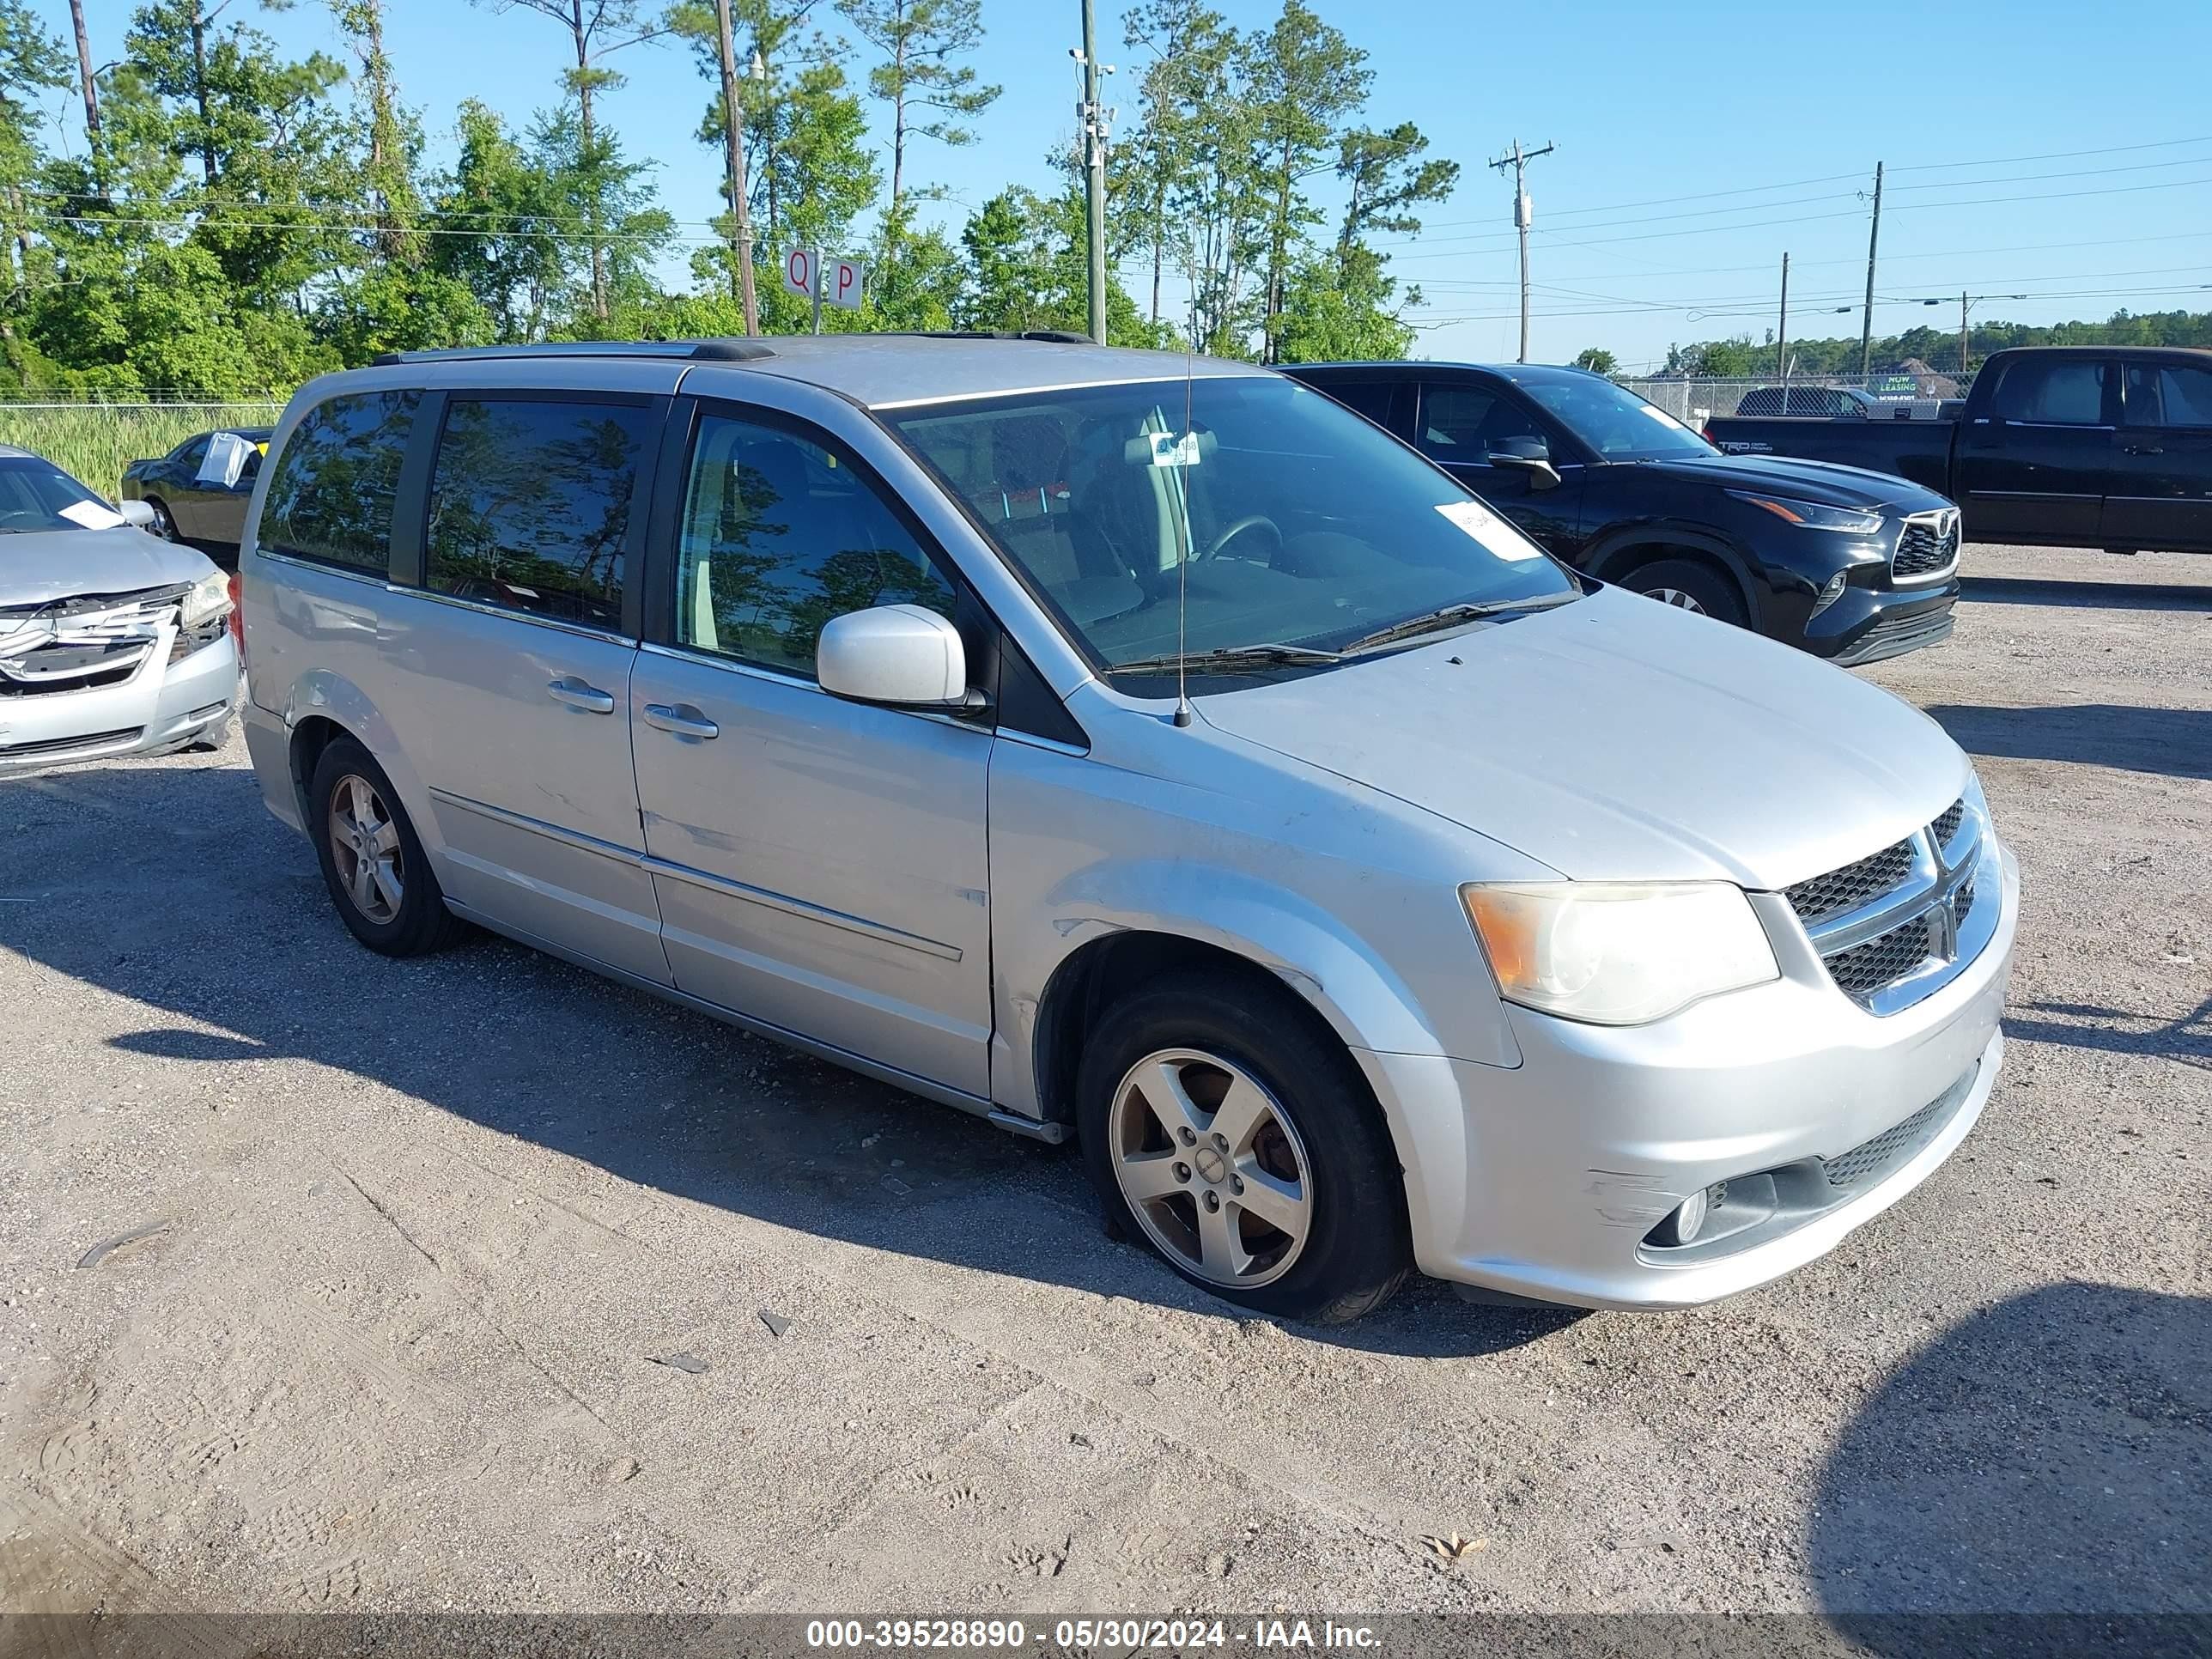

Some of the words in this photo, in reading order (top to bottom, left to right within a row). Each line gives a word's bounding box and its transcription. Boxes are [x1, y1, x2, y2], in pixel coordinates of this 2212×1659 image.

[790, 251, 810, 294] Q
[838, 264, 854, 301] P
[1881, 383, 1917, 392] LEASING
[1718, 441, 1750, 452] TRD
